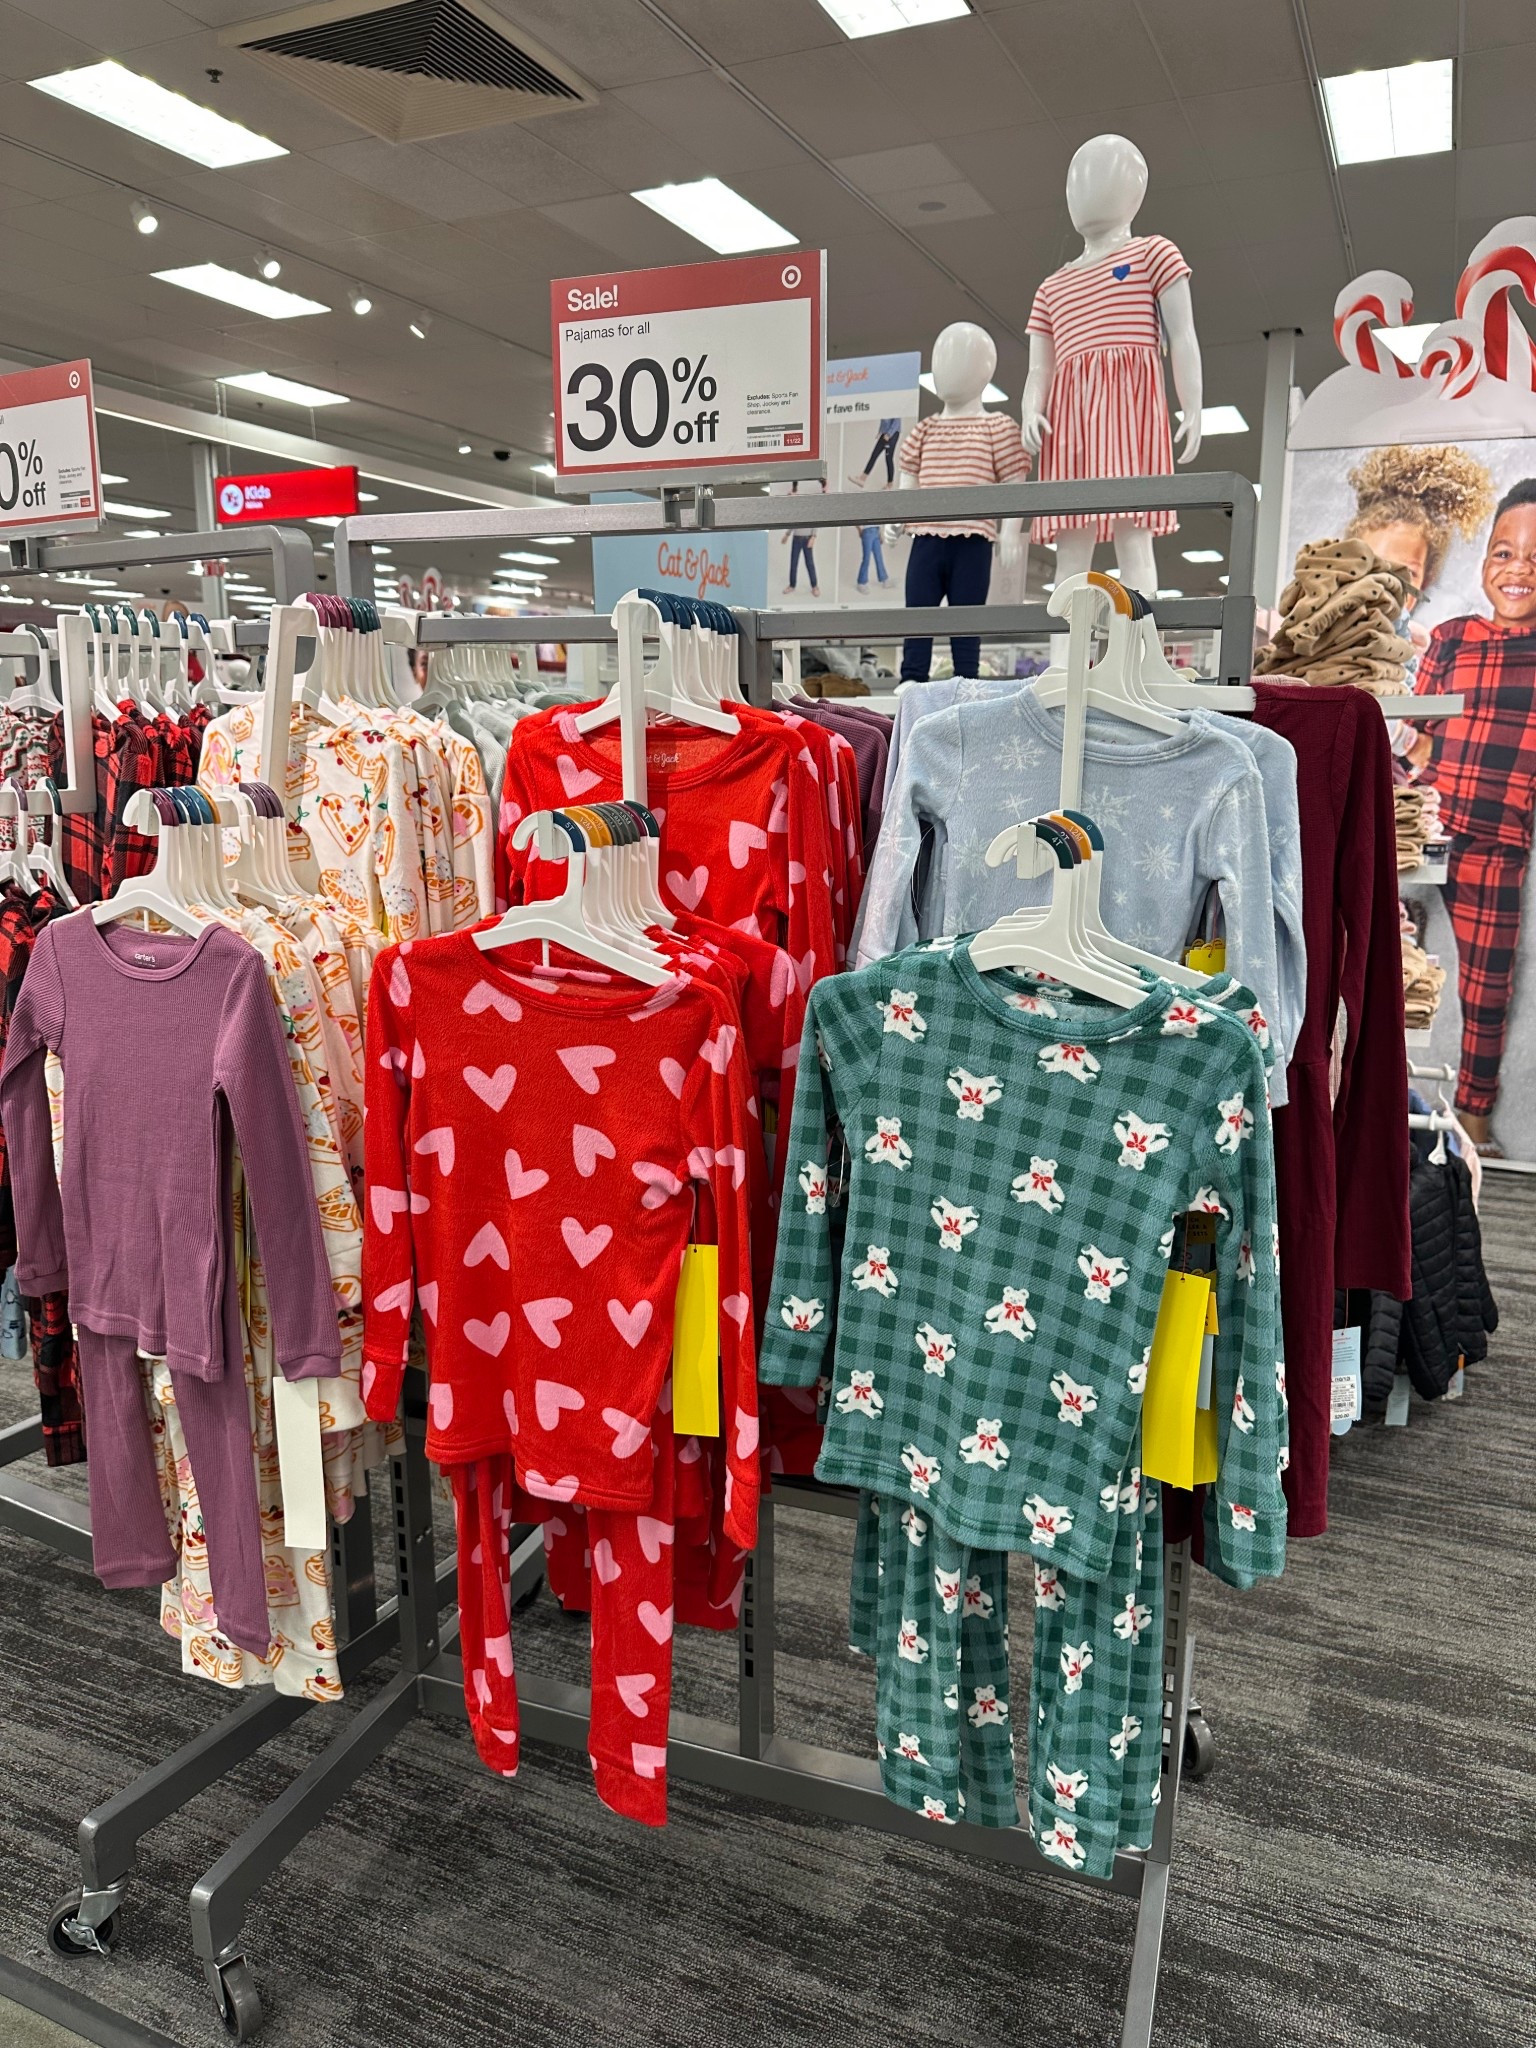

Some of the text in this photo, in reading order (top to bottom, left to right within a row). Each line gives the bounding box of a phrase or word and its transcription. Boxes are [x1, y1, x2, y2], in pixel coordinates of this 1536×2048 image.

[567, 285, 619, 312] Sale!
[566, 321, 651, 343] Pajamas for all
[834, 404, 853, 414] fave
[855, 402, 870, 412] fits
[673, 411, 719, 444] off
[23, 481, 46, 507] off
[658, 541, 731, 600] Cat & Jack
[1052, 837, 1063, 846] 4T
